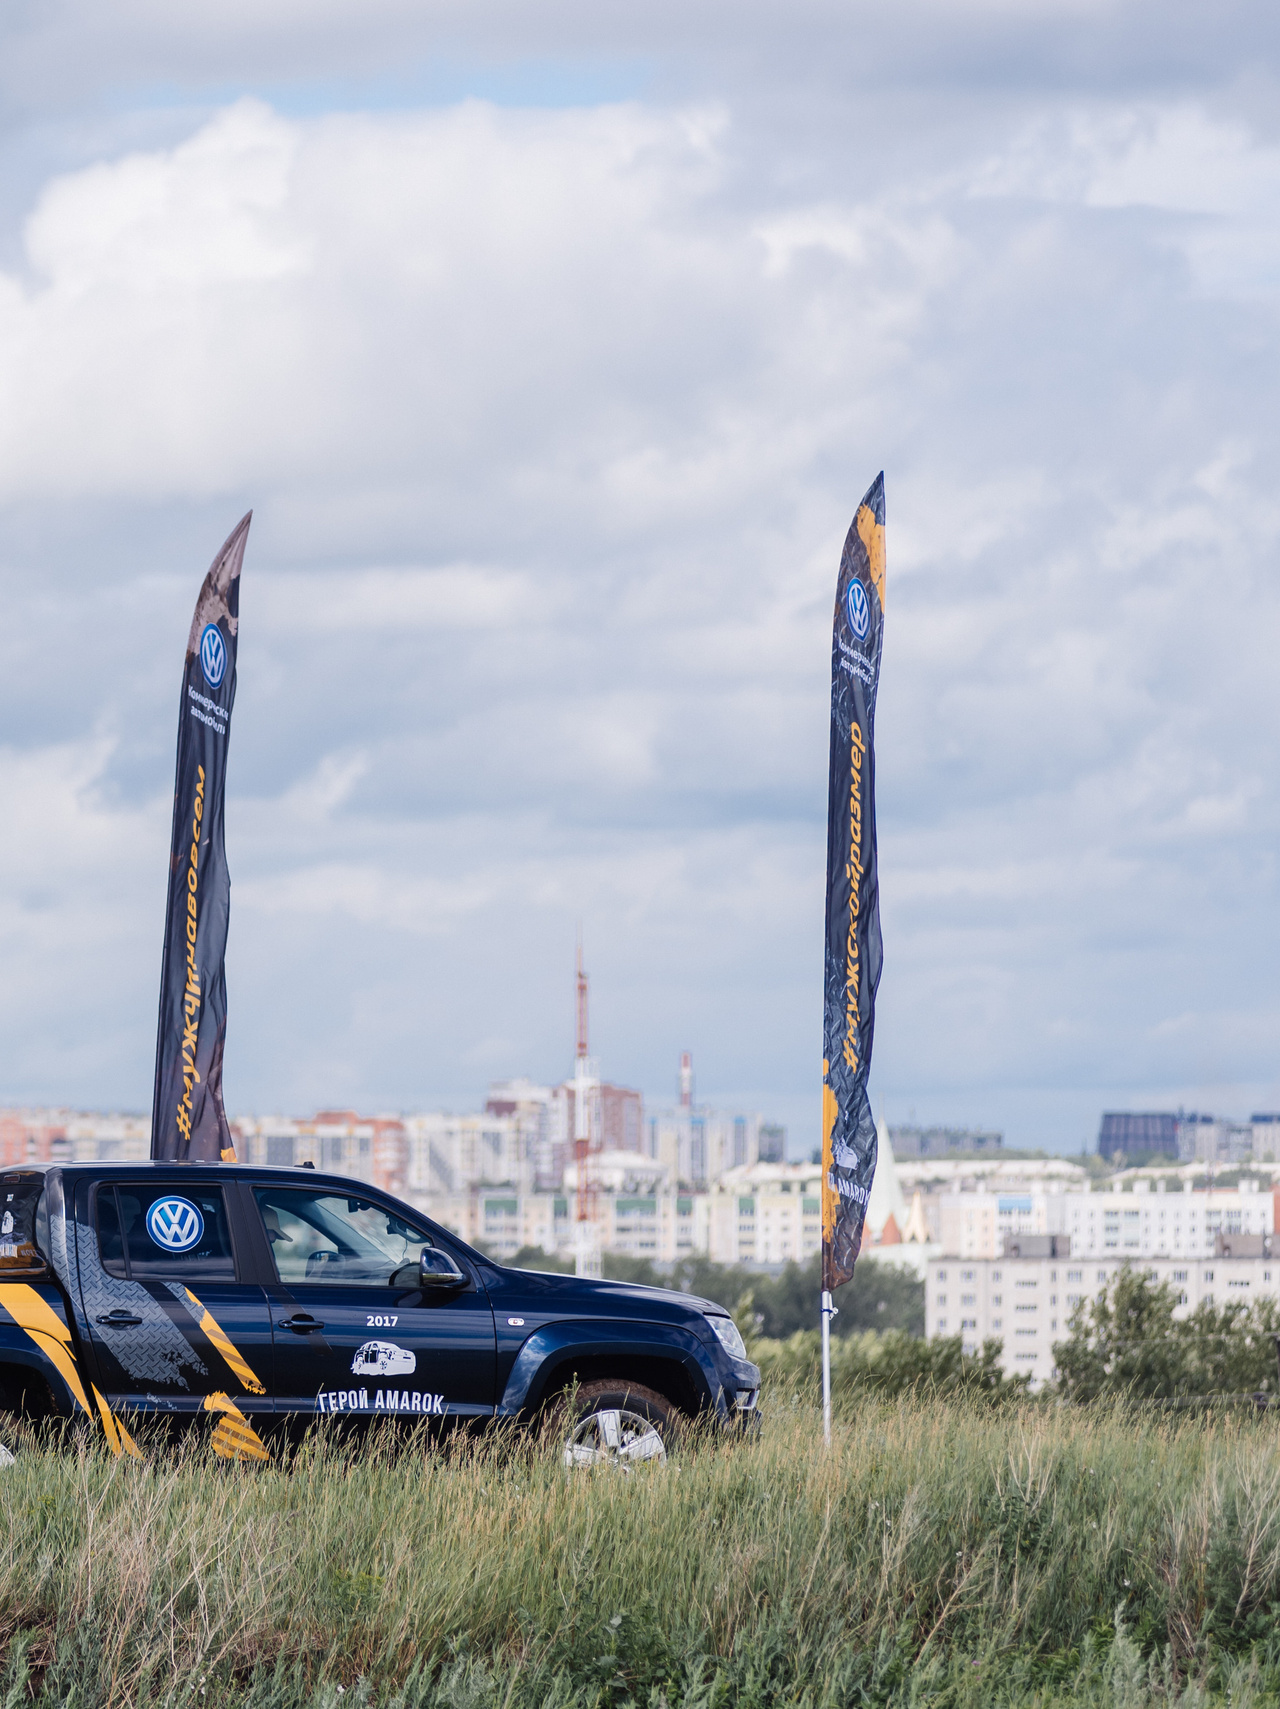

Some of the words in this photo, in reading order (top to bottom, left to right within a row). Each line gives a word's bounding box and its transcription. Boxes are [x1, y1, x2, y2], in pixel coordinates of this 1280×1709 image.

[202, 629, 224, 683] VW
[151, 1200, 200, 1248] VW
[366, 1315, 399, 1327] 2017
[318, 1387, 369, 1413] ГЕРОЙ
[374, 1389, 445, 1414] AMAROK
